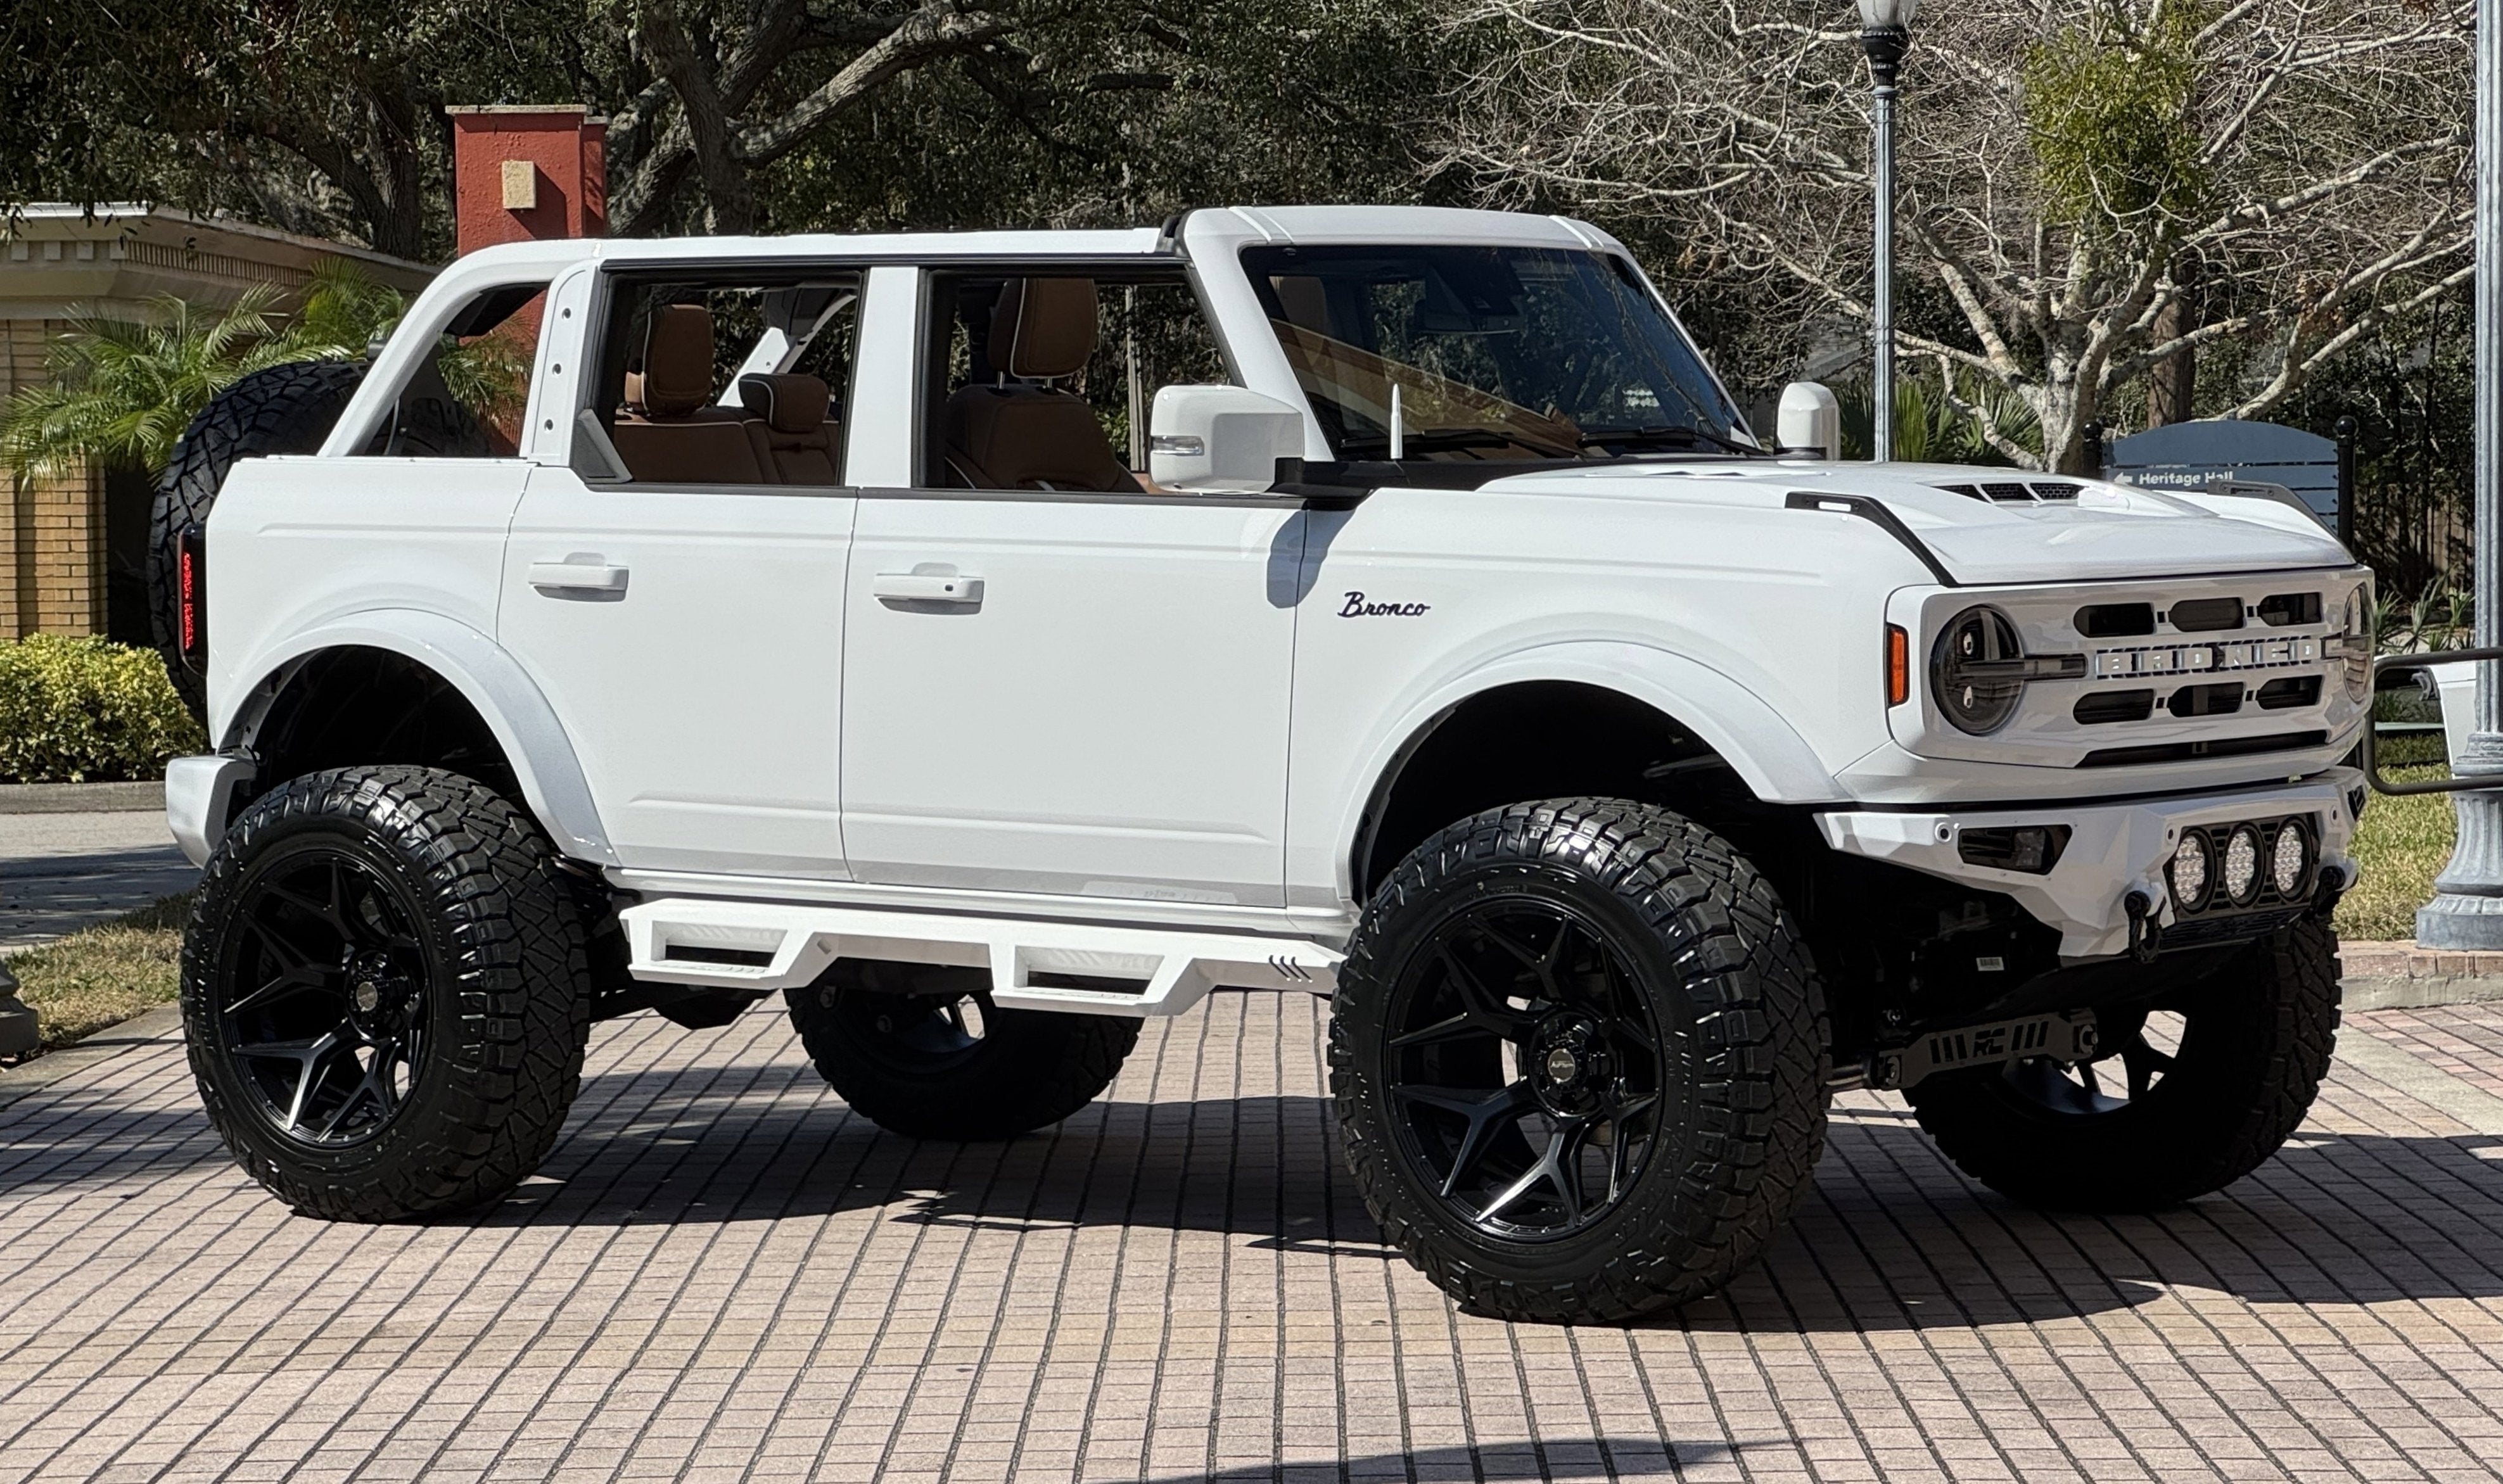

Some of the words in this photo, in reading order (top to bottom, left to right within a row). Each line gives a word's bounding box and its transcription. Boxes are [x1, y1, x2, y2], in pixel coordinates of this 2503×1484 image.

[2139, 471, 2201, 486] Heritage
[1337, 590, 1431, 618] Bronco
[2094, 638, 2323, 678] BRONCO
